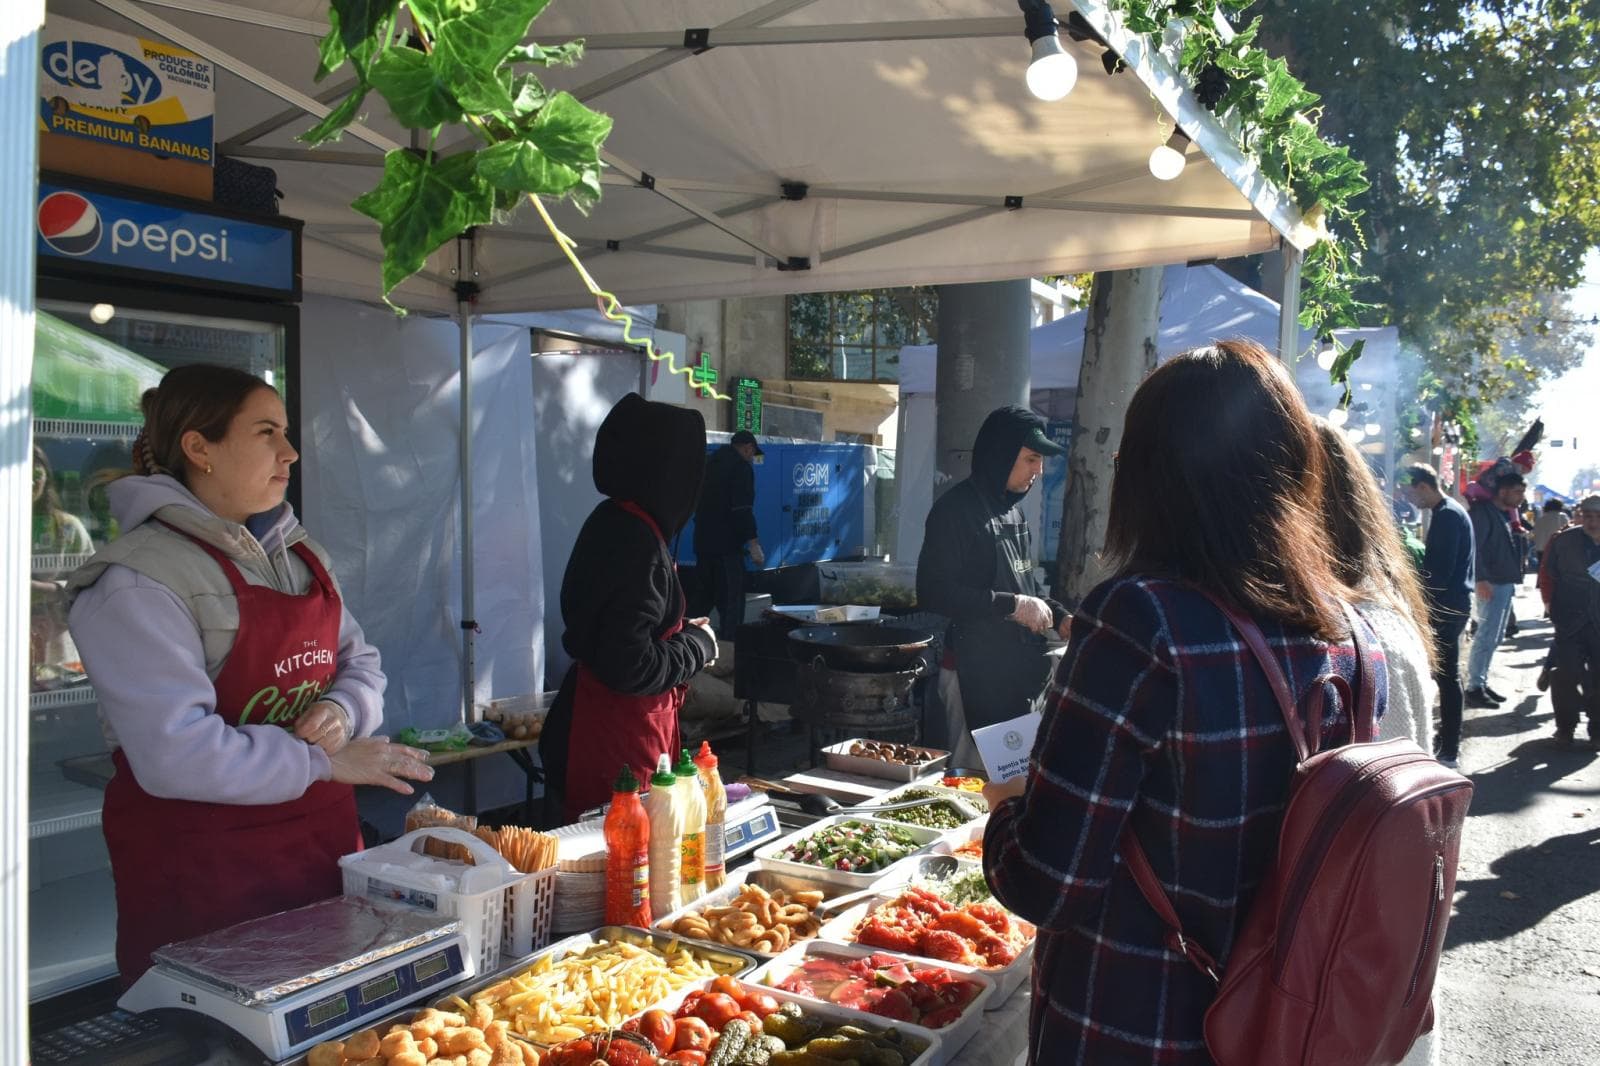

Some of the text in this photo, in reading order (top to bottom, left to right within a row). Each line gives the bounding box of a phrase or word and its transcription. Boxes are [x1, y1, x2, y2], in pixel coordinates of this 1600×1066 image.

[144, 49, 209, 73] PRODUCE OF
[159, 62, 210, 84] COLOMBIA
[167, 75, 192, 86] VACUUM
[53, 115, 210, 161] PREMIUM BANANAS
[112, 219, 228, 263] pepsi
[303, 639, 319, 648] THE
[274, 649, 334, 678] KITCHEN
